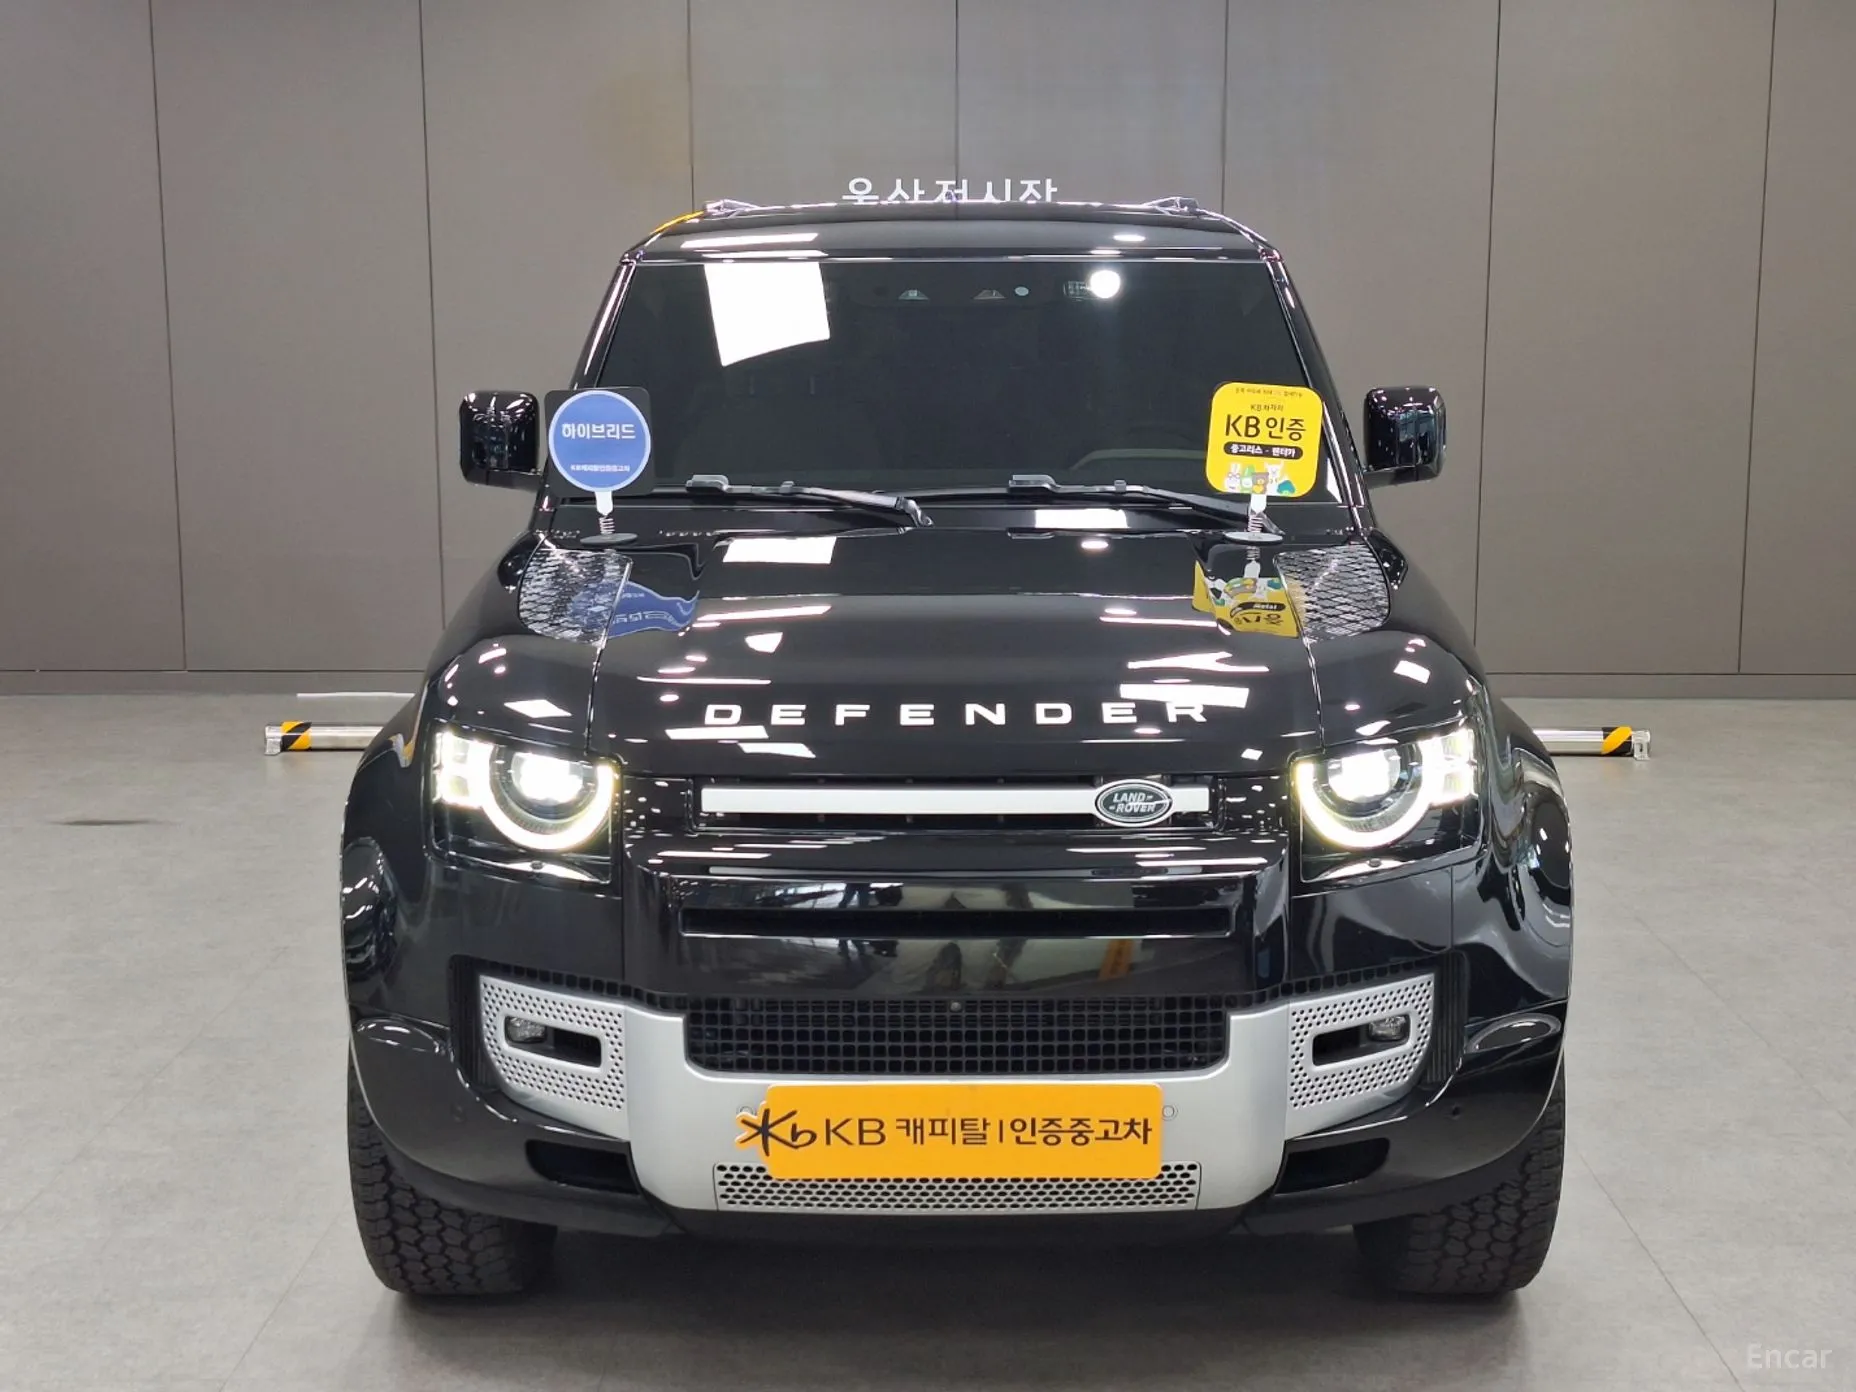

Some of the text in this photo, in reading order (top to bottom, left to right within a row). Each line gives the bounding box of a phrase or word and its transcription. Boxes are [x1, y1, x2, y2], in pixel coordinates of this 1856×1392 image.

[561, 423, 637, 440] 하이브리드
[1225, 414, 1306, 442] KB 인증
[1230, 443, 1264, 455] 중고리스
[1272, 446, 1297, 458] 렌터카
[704, 702, 1208, 726] DEFENDER
[824, 1117, 888, 1147] KB
[895, 1116, 991, 1146] 캐피탈
[1009, 1116, 1153, 1146] 인증중고차
